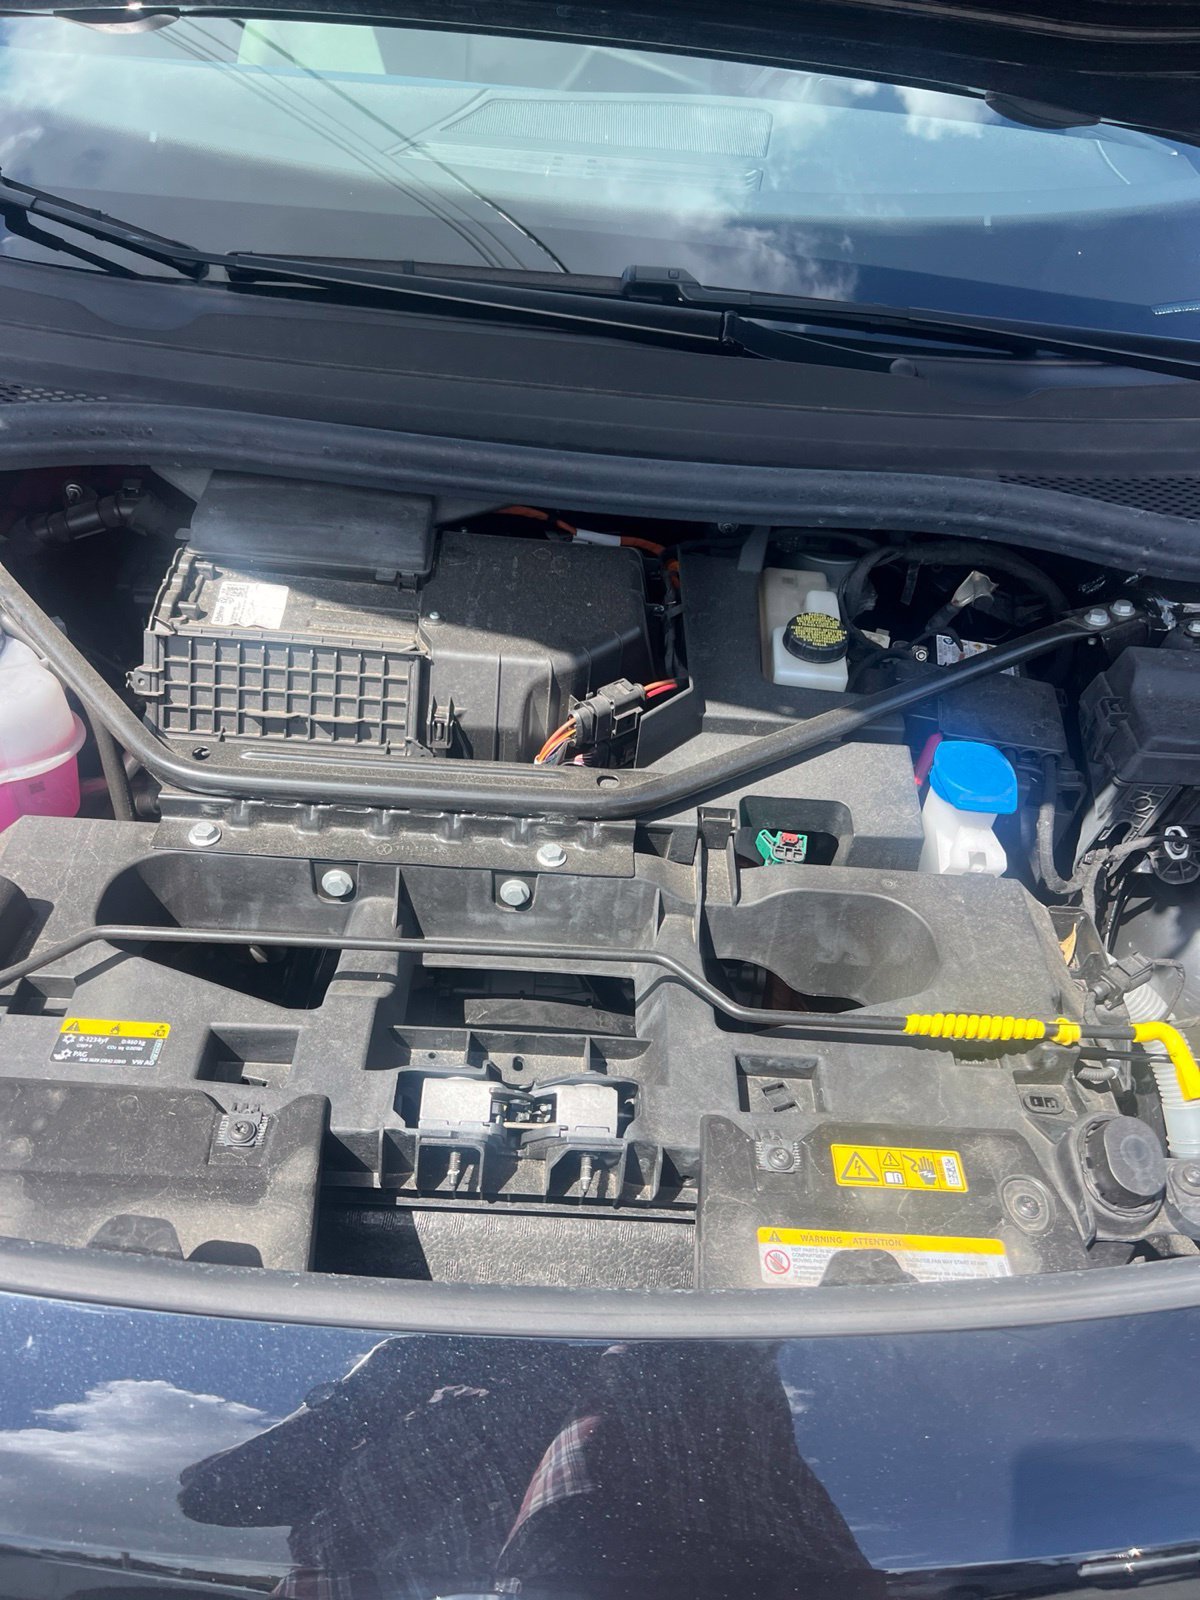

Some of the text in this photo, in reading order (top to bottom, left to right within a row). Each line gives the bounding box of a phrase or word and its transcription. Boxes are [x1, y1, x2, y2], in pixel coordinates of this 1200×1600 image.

[72, 1050, 88, 1058] PAG
[800, 1234, 902, 1247] WARNING ATTENTION
